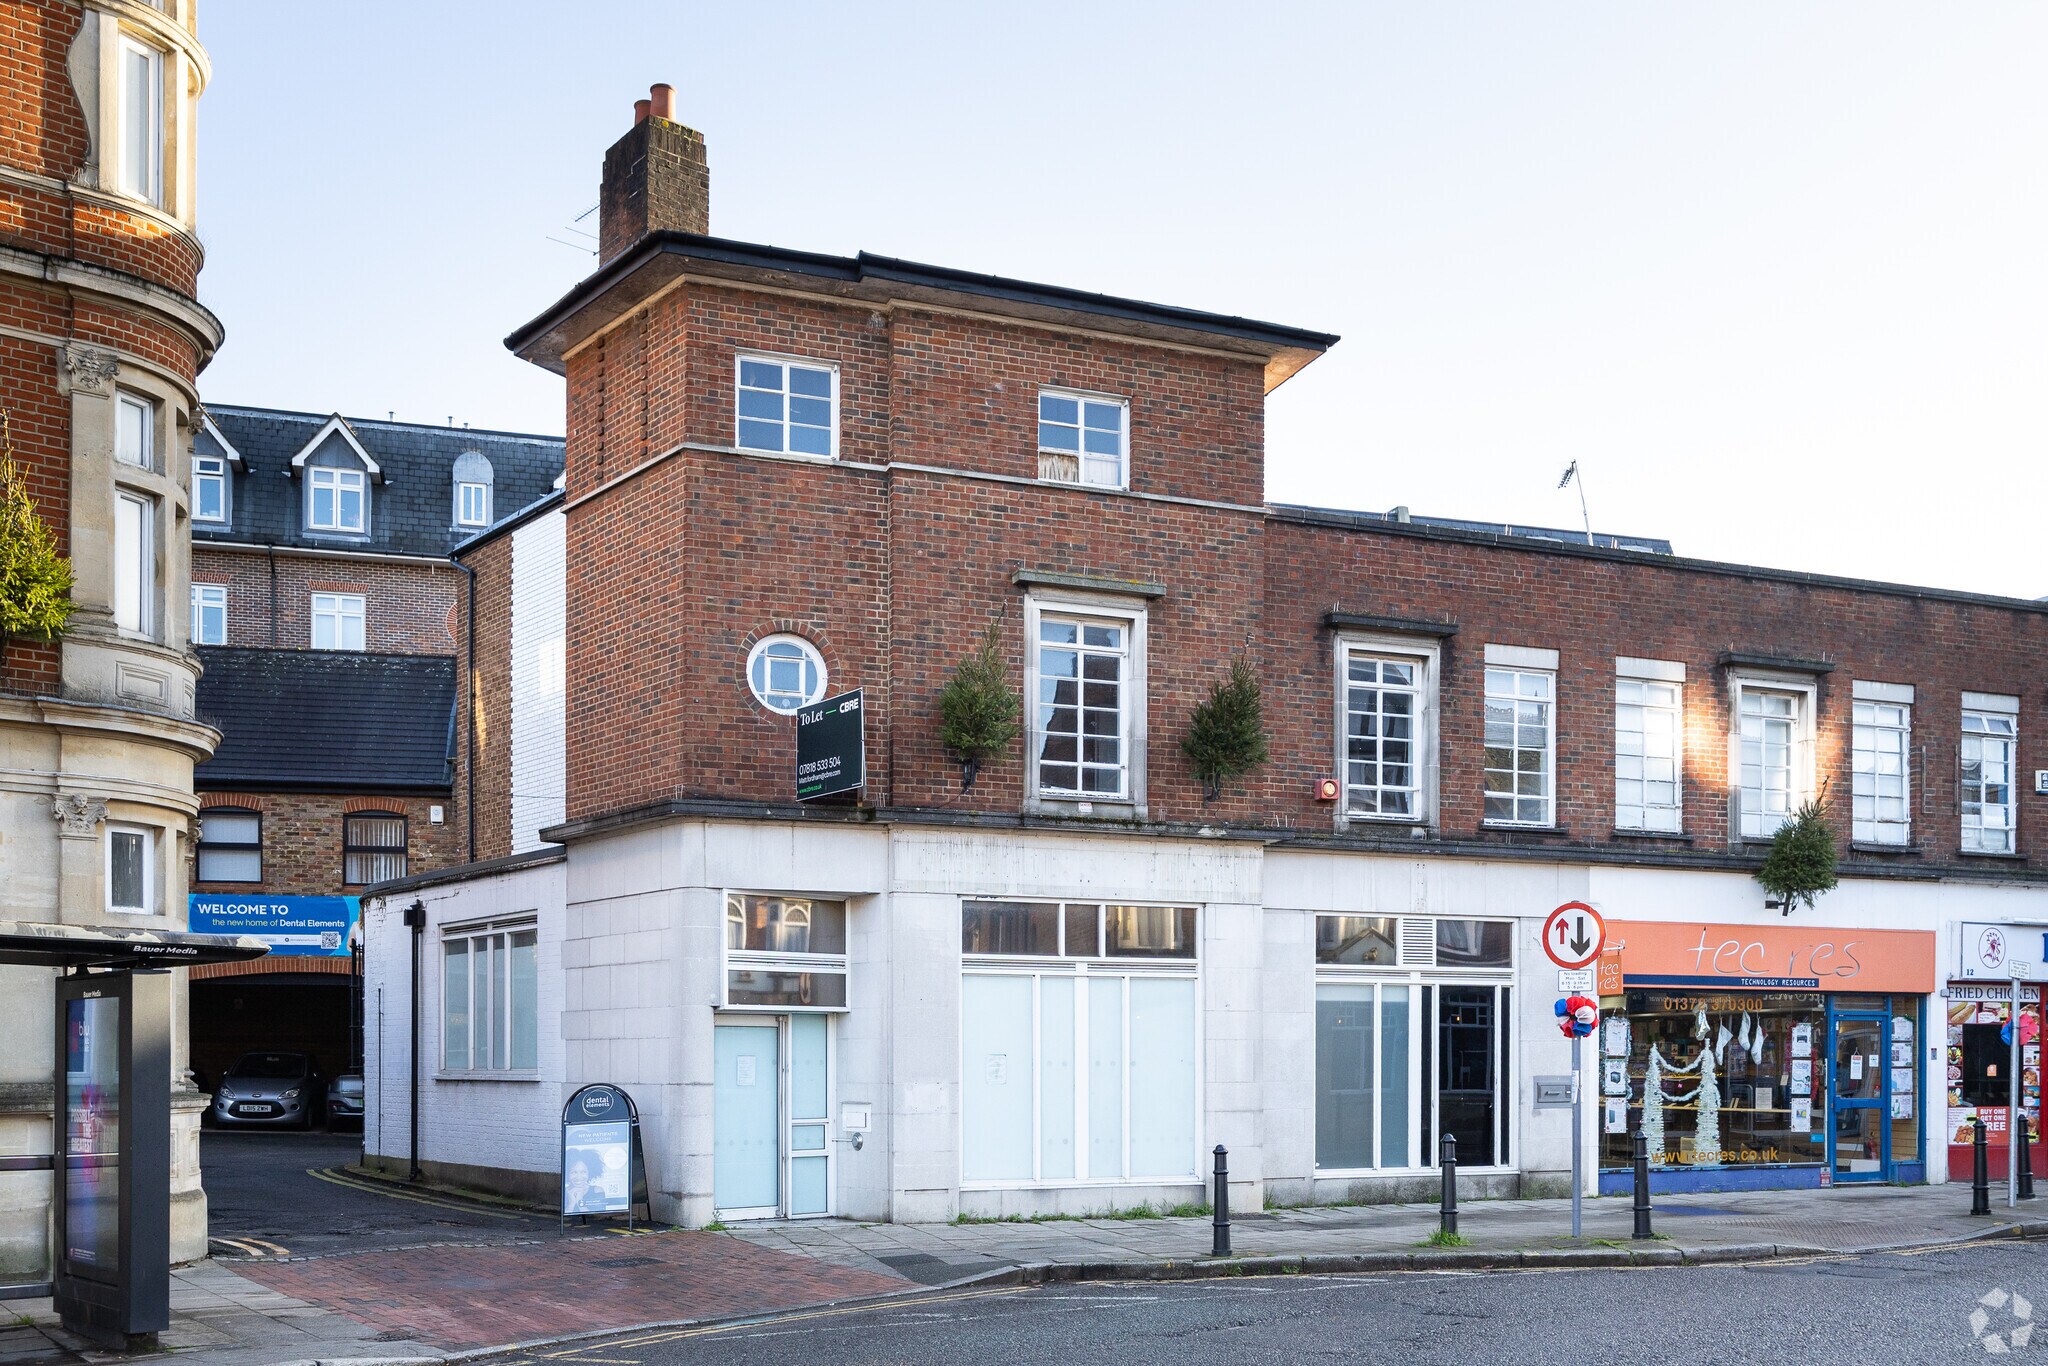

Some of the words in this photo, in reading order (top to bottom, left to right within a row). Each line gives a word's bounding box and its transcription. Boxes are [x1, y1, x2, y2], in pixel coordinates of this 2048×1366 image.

[839, 698, 859, 713] CBRE
[800, 713, 810, 726] To
[811, 710, 823, 723] Let
[817, 759, 828, 771] 533
[829, 756, 841, 768] 504
[197, 904, 267, 914] WELCOME
[270, 904, 289, 915] TO
[212, 918, 225, 926] the
[245, 918, 267, 926] home
[270, 918, 279, 926] of
[280, 919, 306, 927] Dental
[307, 919, 345, 927] Elements
[133, 945, 165, 953] Bauer
[1685, 926, 1770, 975] tec
[1788, 940, 1864, 978] res
[1600, 961, 1619, 976] tec
[1599, 976, 1619, 989] res
[1741, 978, 1779, 986] TECHNOLOGY
[1948, 987, 1983, 998] FRIED
[1664, 996, 1706, 1010] 01372
[1711, 997, 1763, 1011] 370300
